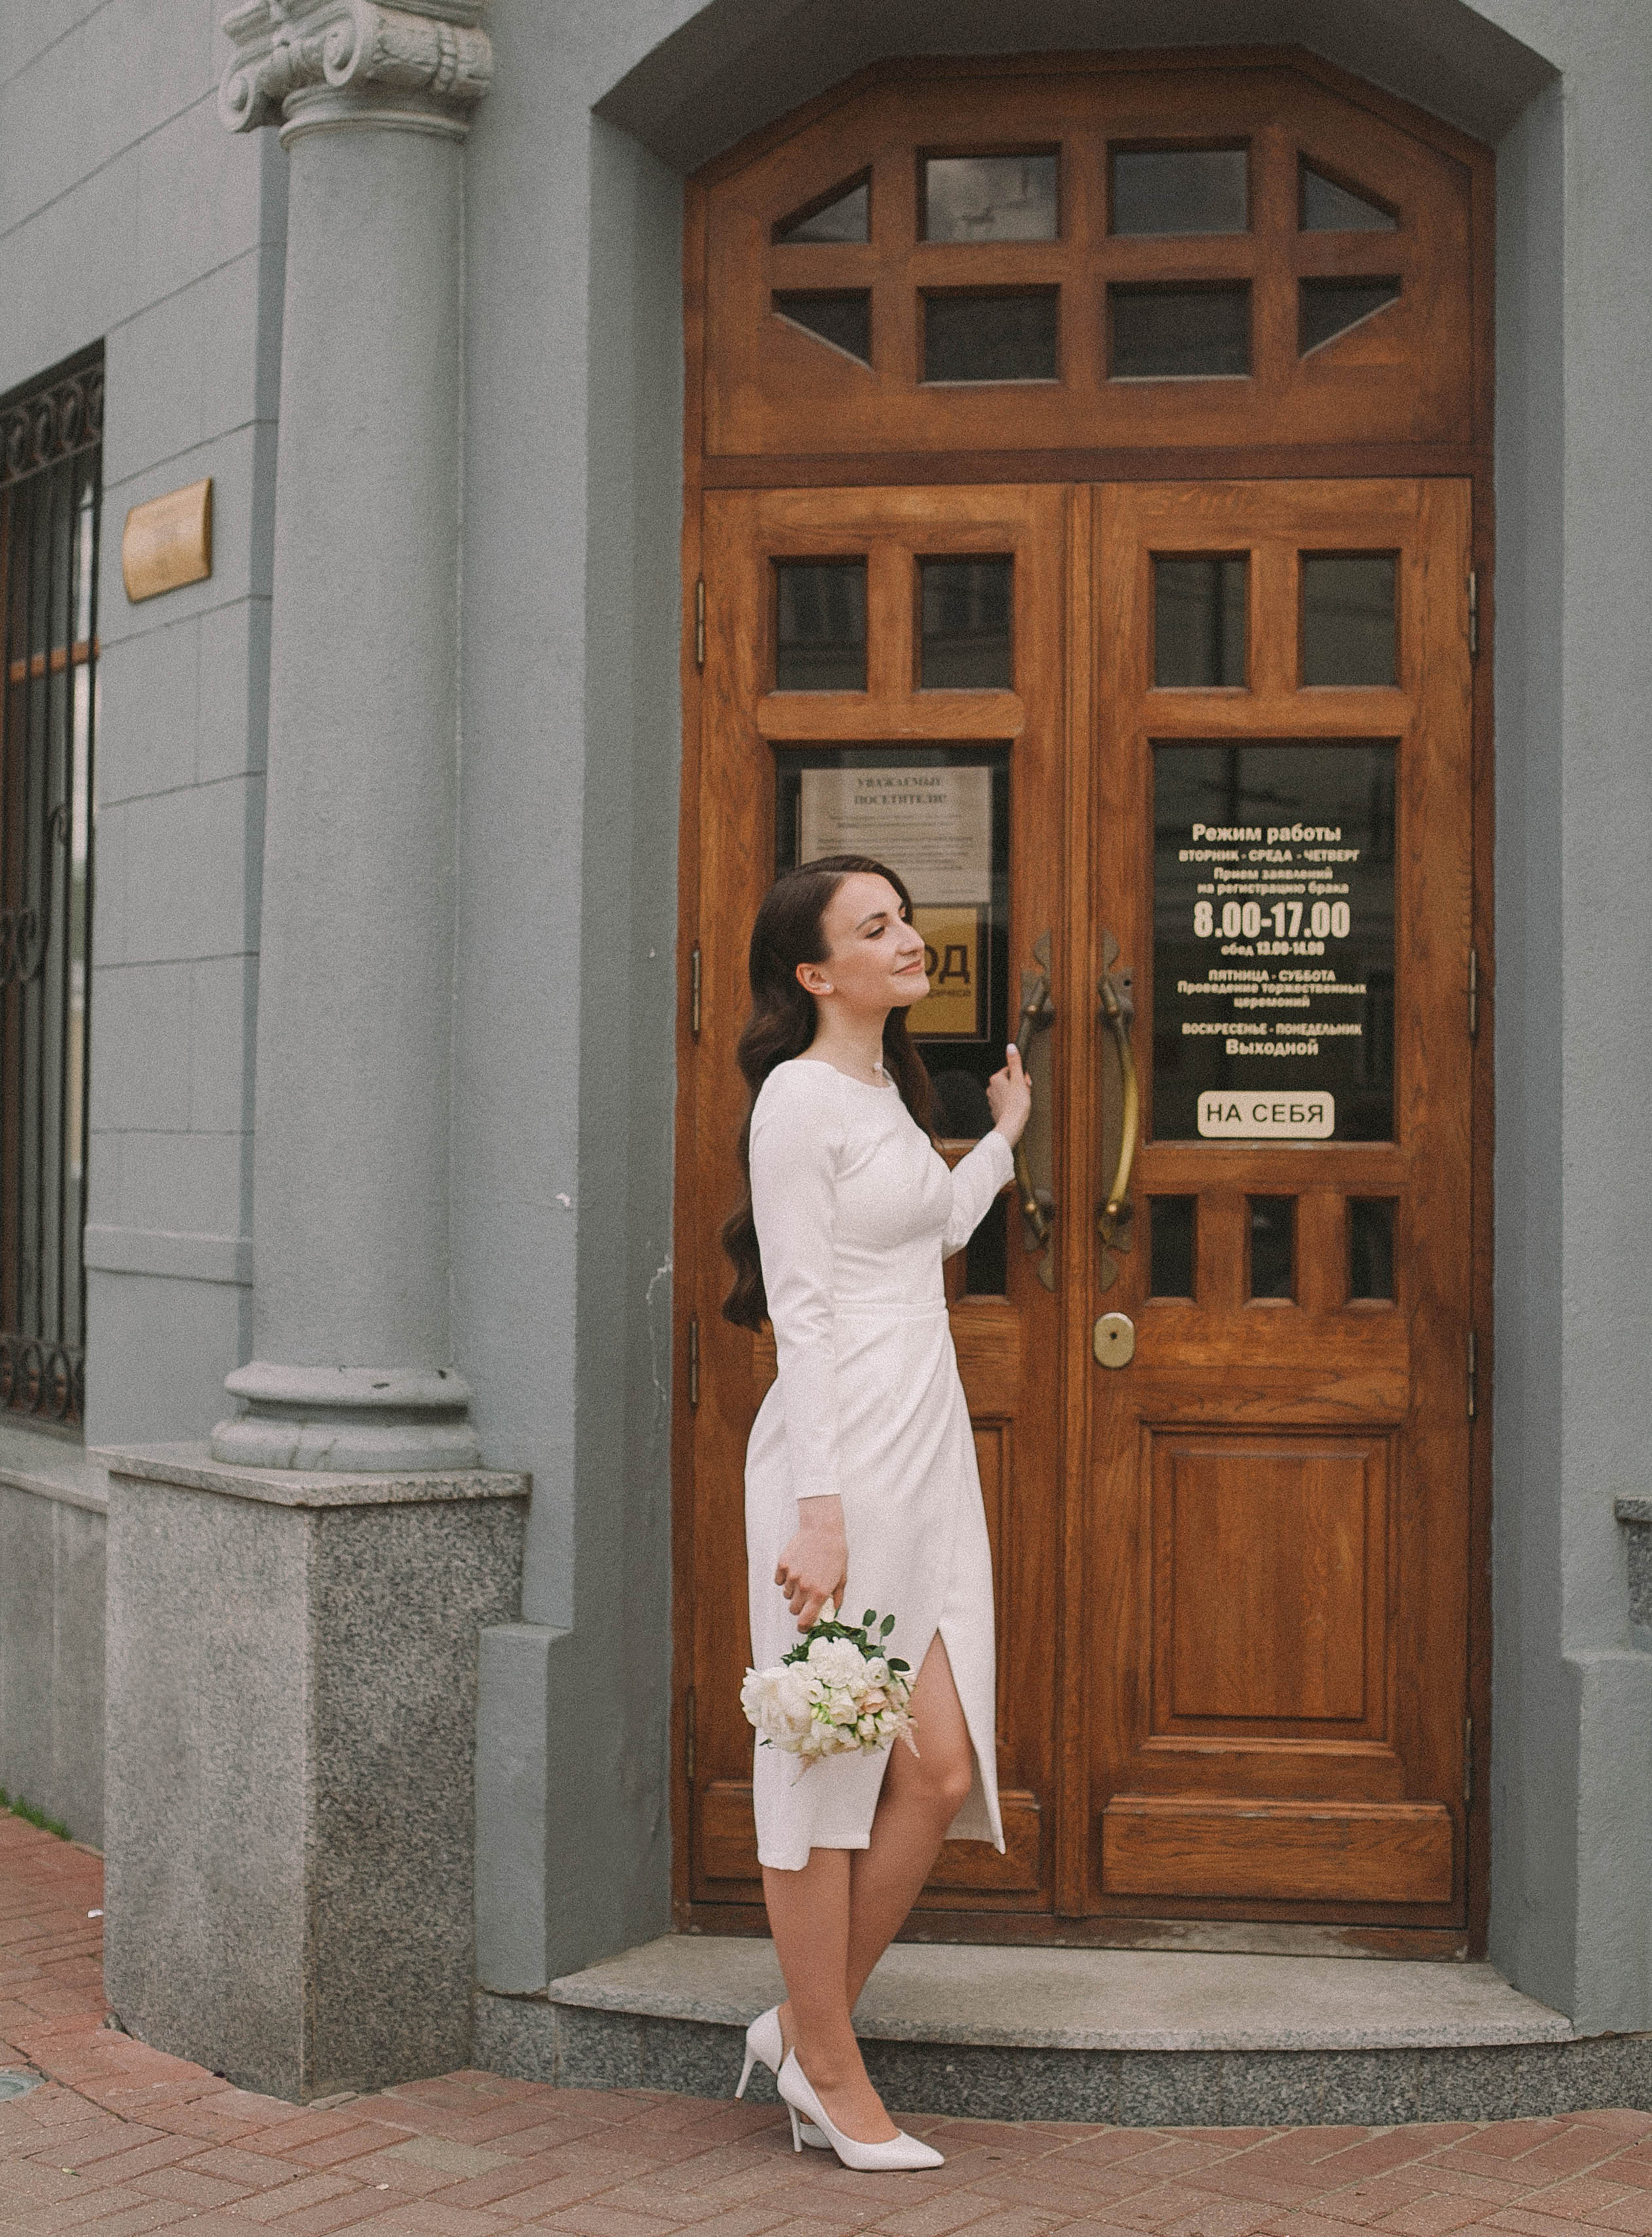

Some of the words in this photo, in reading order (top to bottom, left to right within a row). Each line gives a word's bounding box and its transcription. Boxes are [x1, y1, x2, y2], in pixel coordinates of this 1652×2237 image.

[1193, 824, 1261, 841] Режим
[1268, 824, 1340, 844] работы
[1179, 850, 1239, 861] ВТОРНИК
[1249, 849, 1292, 862] СРЕДА
[1194, 901, 1349, 938] 8.00-17.00
[1221, 943, 1254, 955] обед
[1209, 970, 1269, 982] ПЯТНИЦА
[1279, 971, 1335, 981] СУББОТА
[1183, 1024, 1266, 1035] ВОСКРЕСЕНЬЕ
[1226, 1039, 1318, 1056] Выходной
[1207, 1104, 1241, 1121] НА
[1253, 1104, 1323, 1122] СЕБЯ
